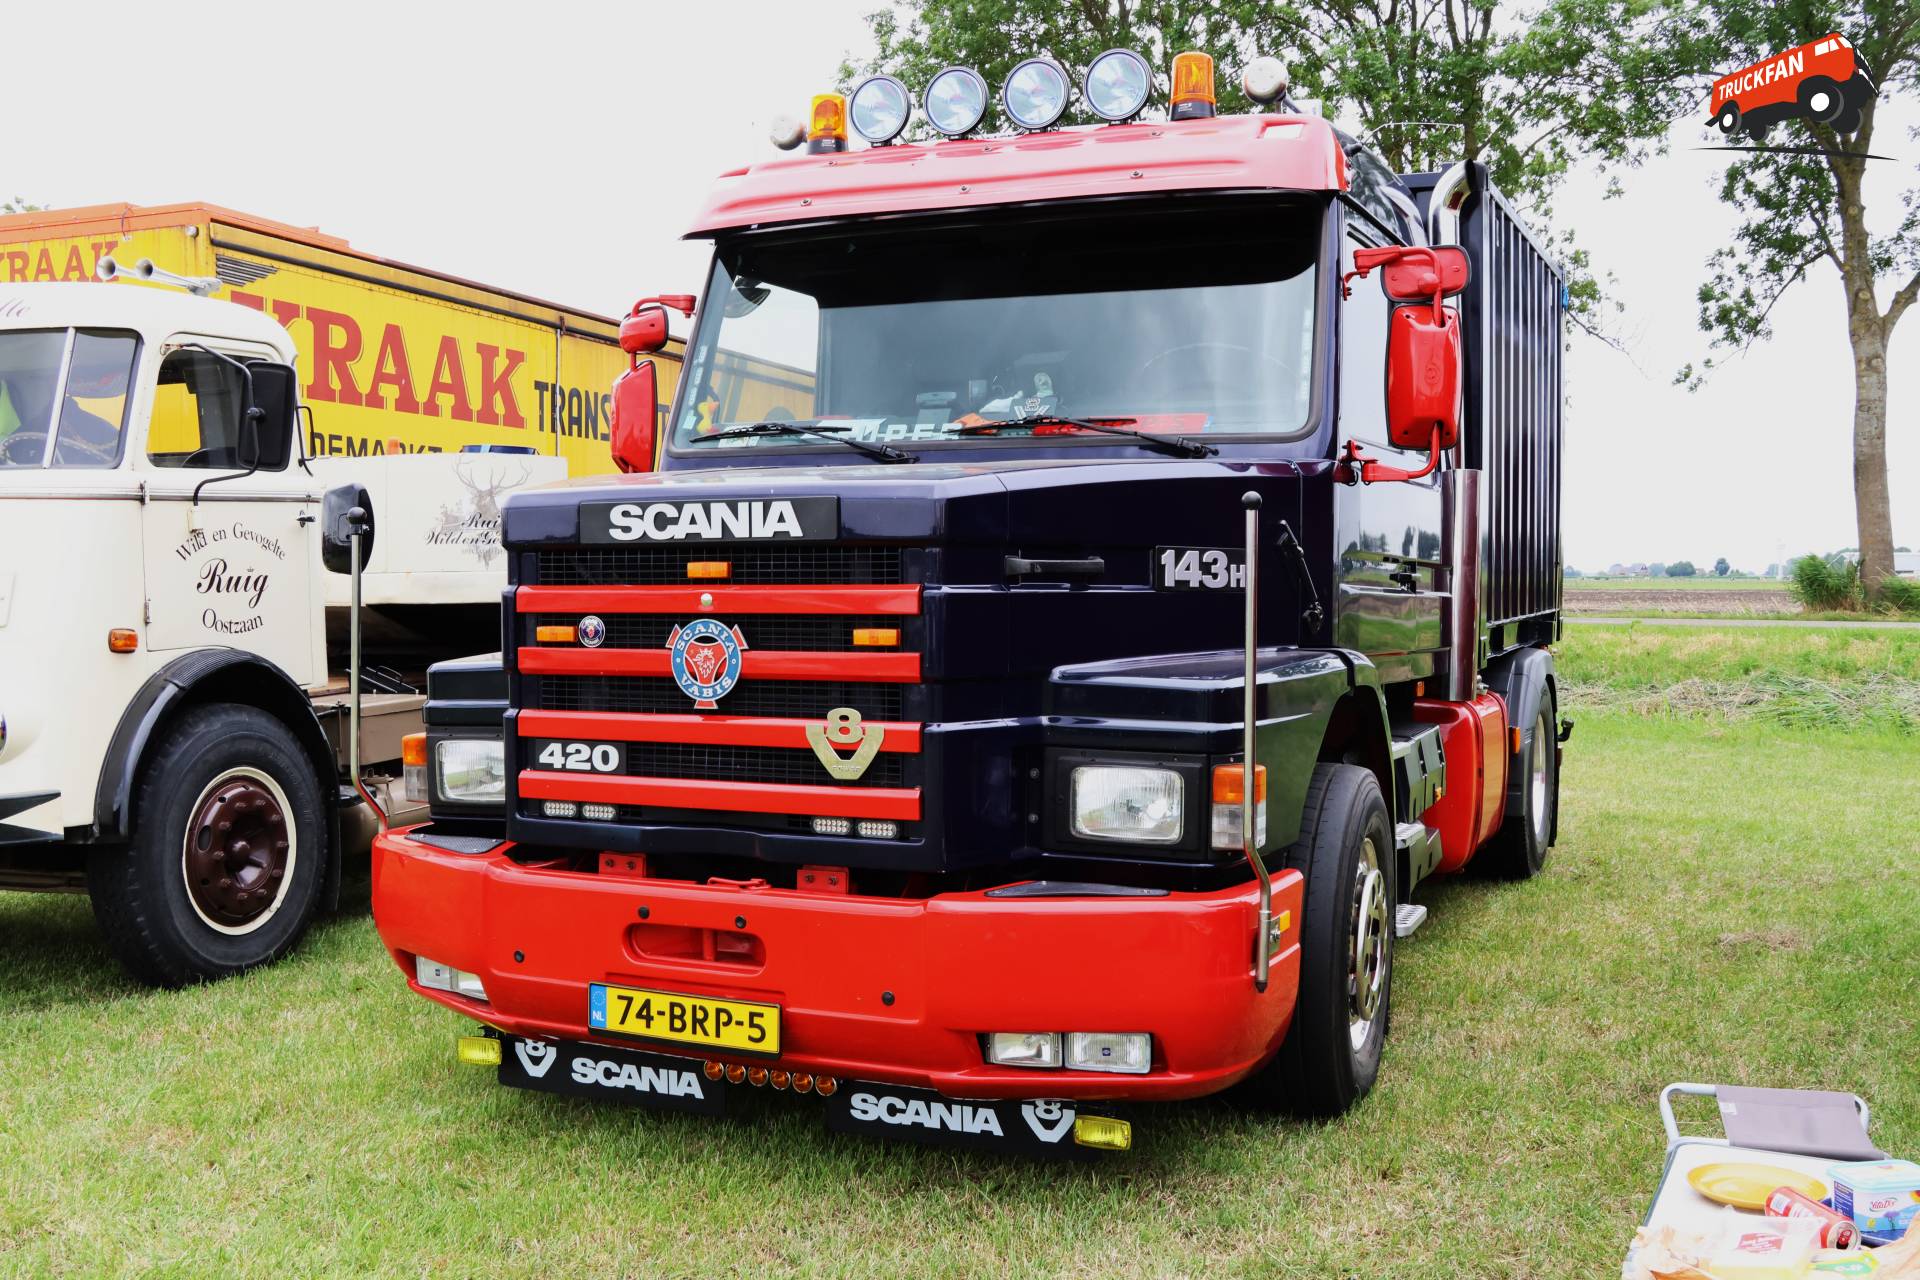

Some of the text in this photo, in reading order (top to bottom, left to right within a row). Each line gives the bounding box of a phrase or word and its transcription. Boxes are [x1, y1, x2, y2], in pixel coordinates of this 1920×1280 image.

[0, 241, 119, 282] RAAK
[608, 500, 803, 541] SCANIA
[176, 522, 286, 561] Wild en Gevogelte
[196, 557, 269, 609] Ruig
[202, 608, 264, 634] Oostzaan
[676, 623, 736, 651] SCANIA
[680, 674, 733, 698] VABIS
[538, 742, 620, 772] 420
[592, 995, 767, 1044] NL 74-BRP-5
[571, 1057, 704, 1099] SCANIA
[850, 1092, 1004, 1137] SCANIA
